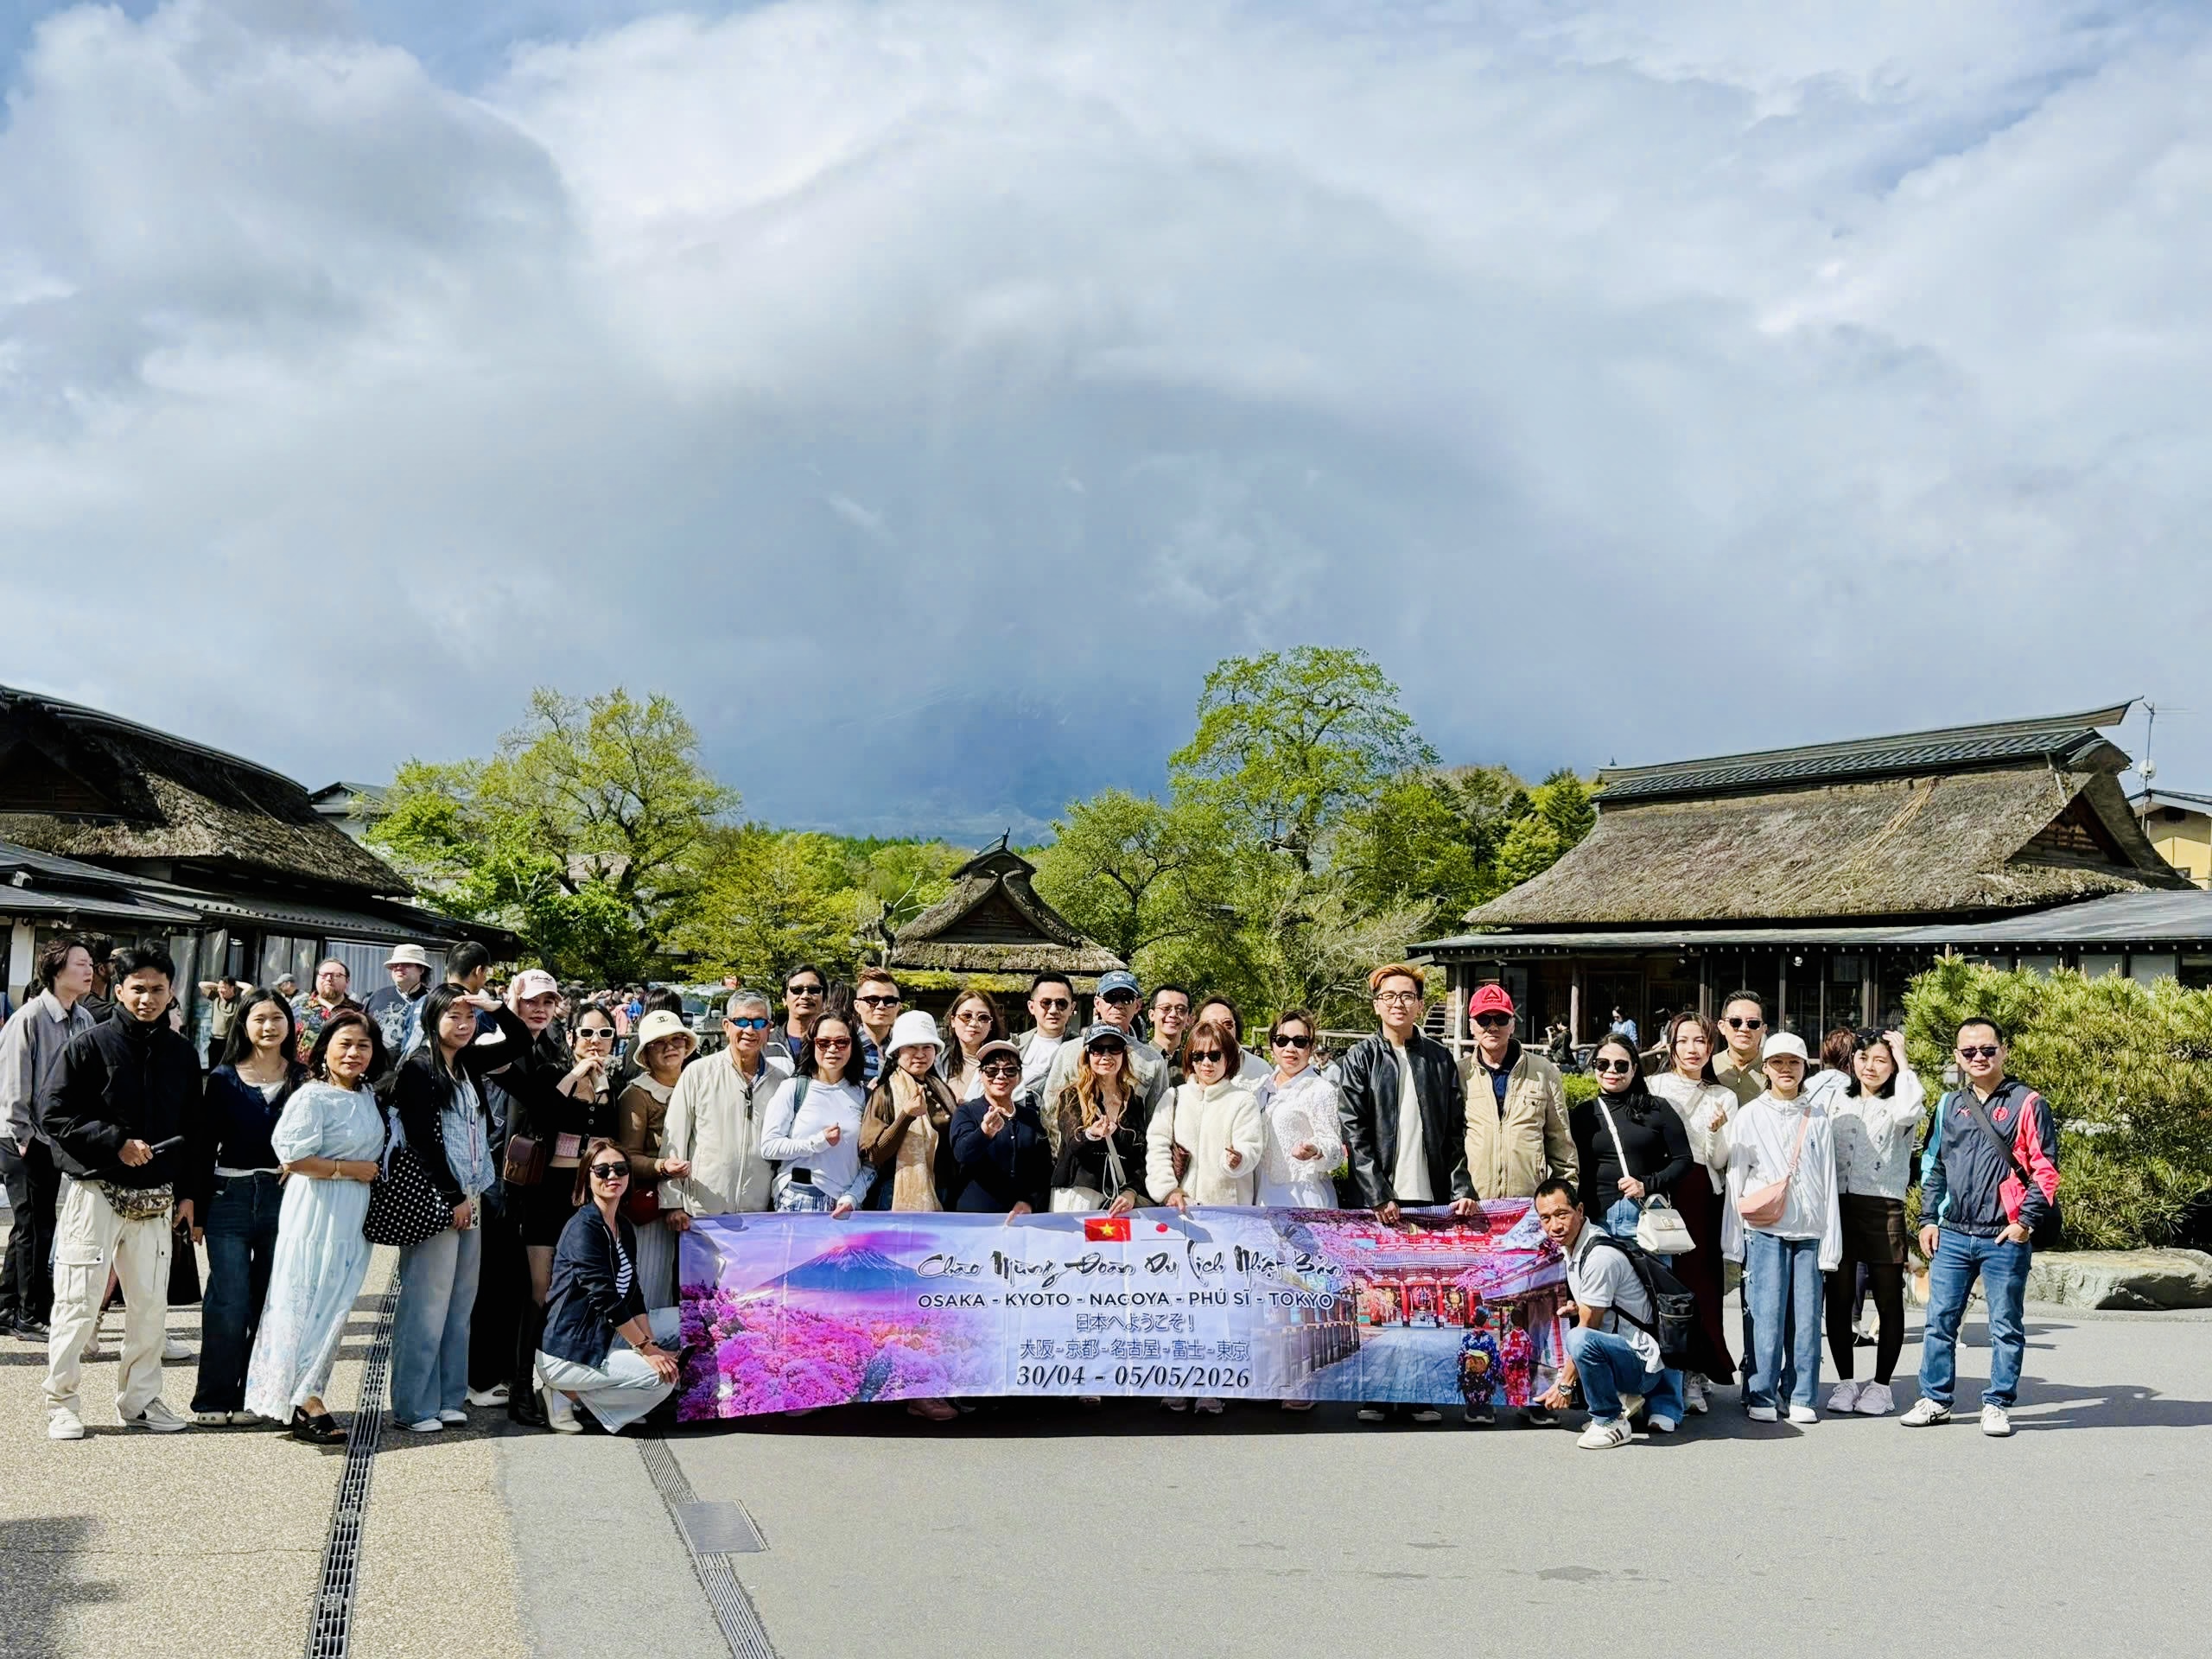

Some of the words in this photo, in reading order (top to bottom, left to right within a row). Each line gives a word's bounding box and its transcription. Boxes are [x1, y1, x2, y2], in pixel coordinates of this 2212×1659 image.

[1145, 1252, 1178, 1274] Du
[918, 1294, 985, 1307] OSAKA
[1006, 1294, 1069, 1306] KYOTO
[1269, 1293, 1332, 1307] TOKYO
[1017, 1365, 1084, 1388] 30/04
[1116, 1365, 1249, 1389] 05/05/2026
